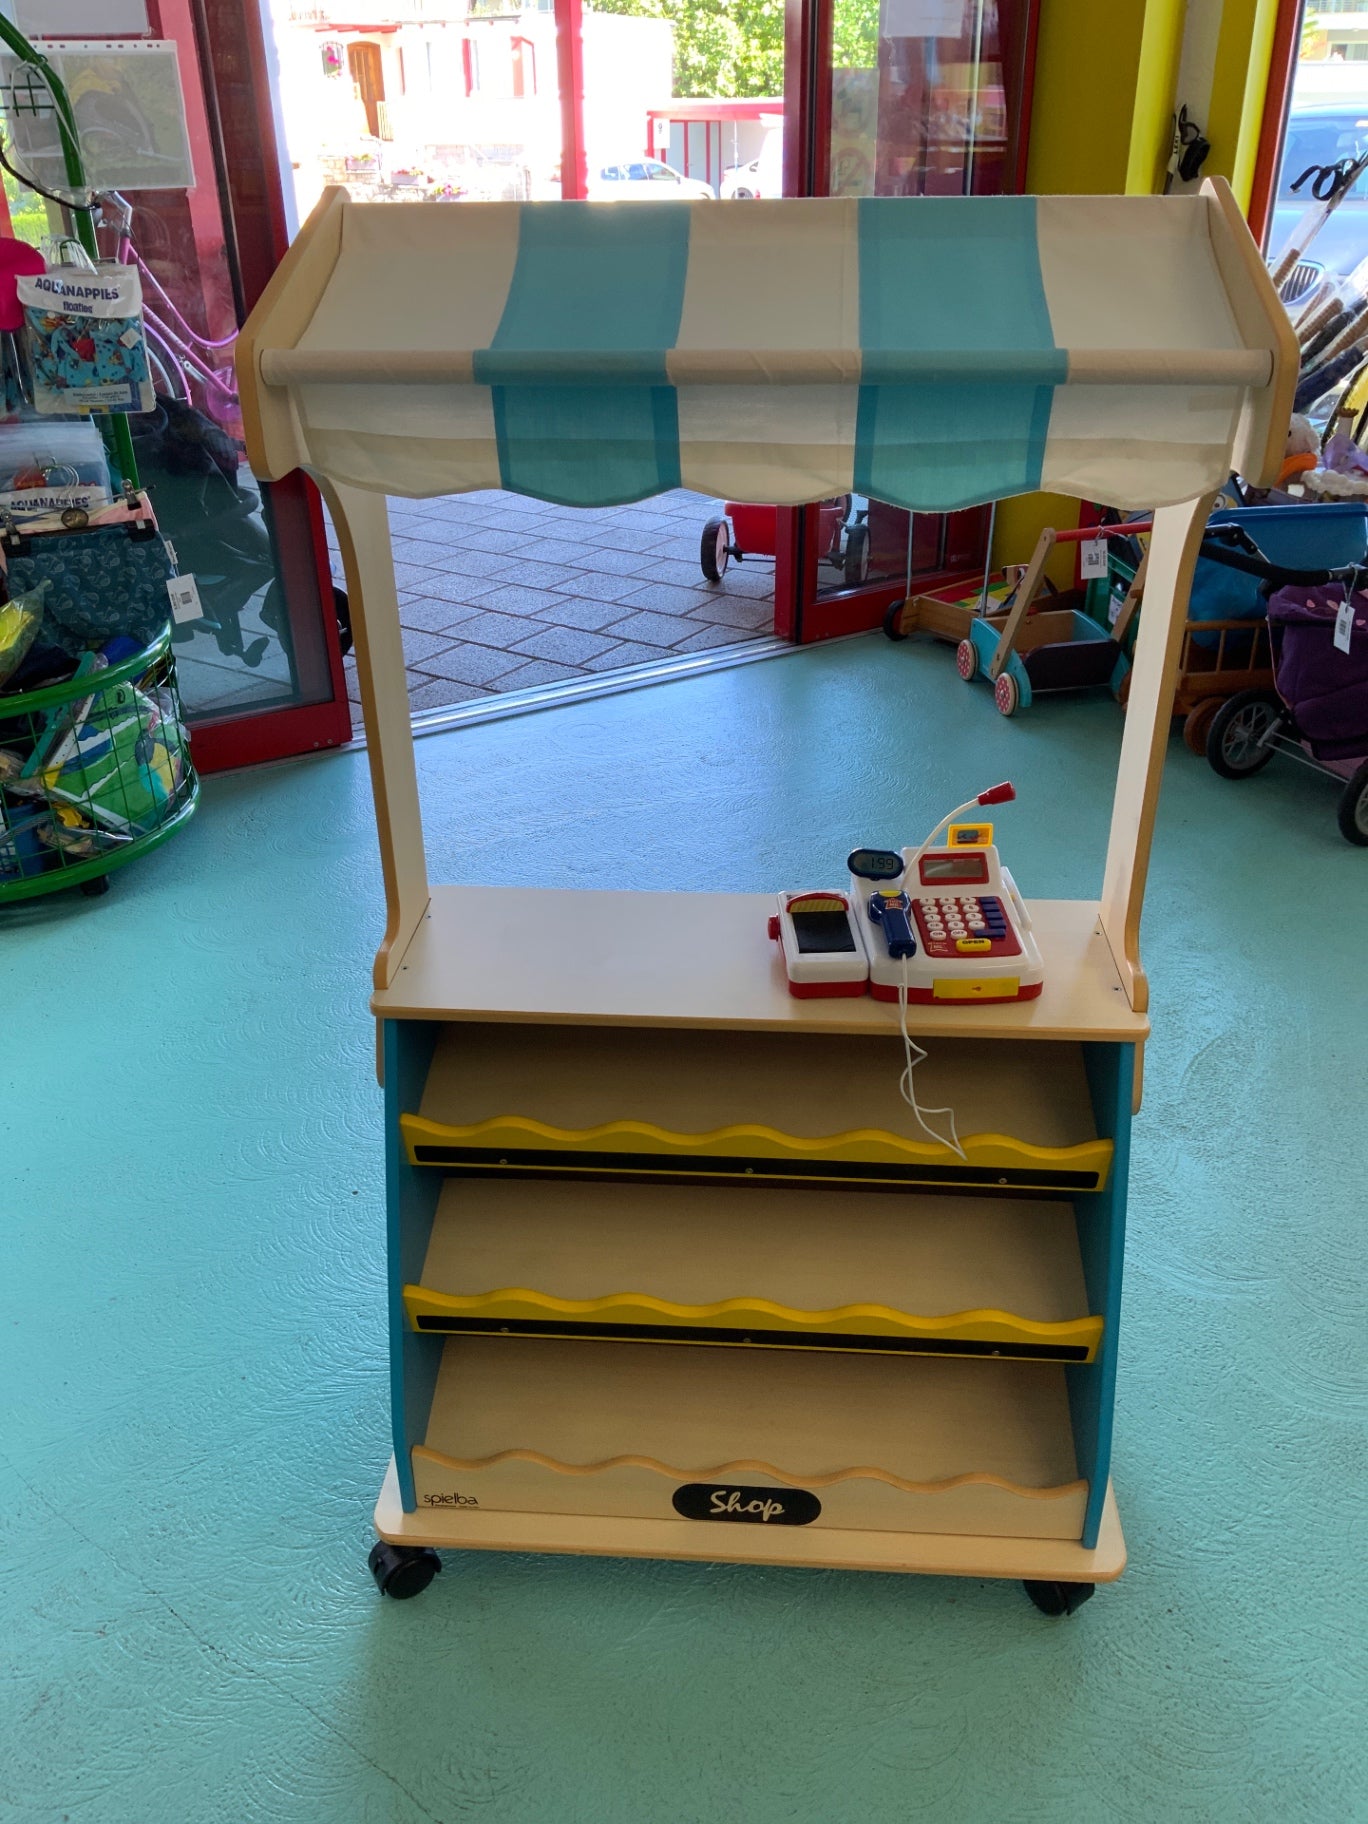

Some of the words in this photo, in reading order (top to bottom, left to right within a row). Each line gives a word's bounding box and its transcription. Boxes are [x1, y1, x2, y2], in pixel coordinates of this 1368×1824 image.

[62, 301, 93, 314] floaties
[423, 1492, 479, 1506] spielba
[710, 1490, 785, 1521] Shop
